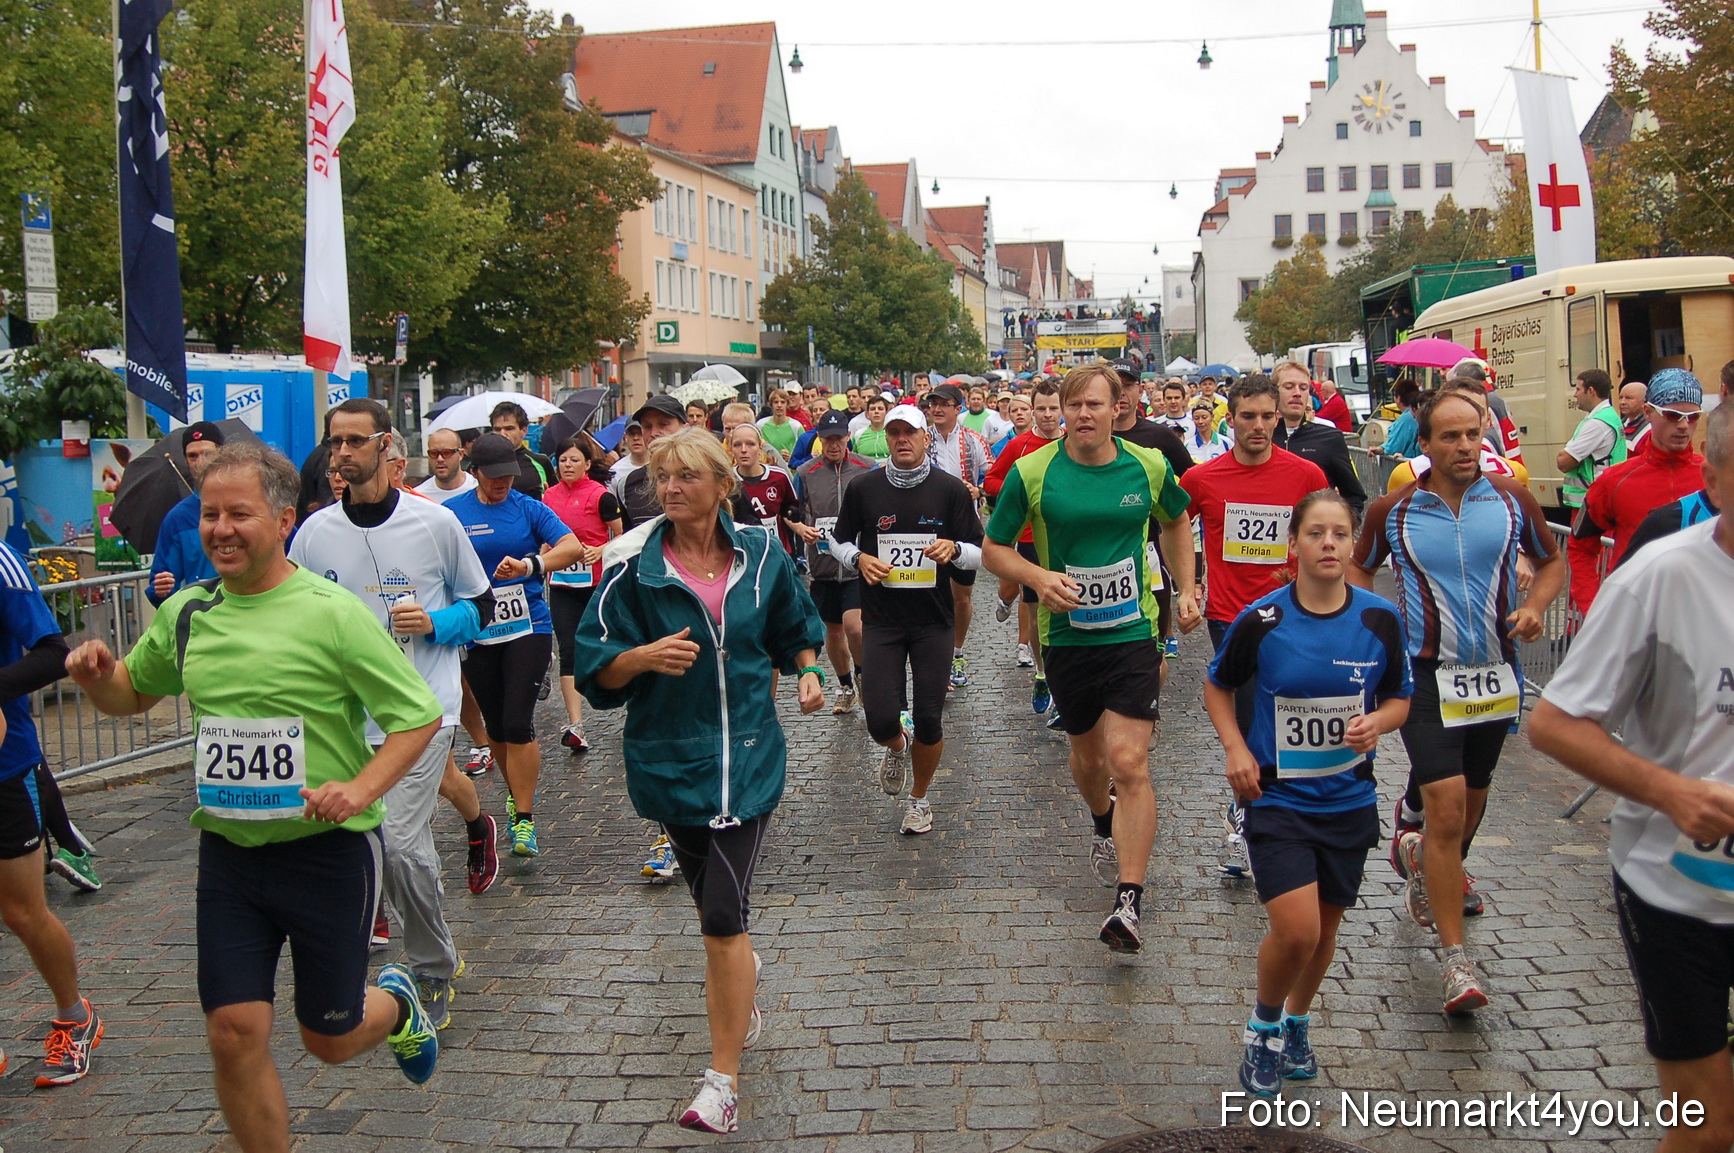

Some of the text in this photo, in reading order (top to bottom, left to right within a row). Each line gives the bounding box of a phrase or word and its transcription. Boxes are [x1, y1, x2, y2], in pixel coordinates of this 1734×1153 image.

[660, 324, 676, 340] D
[1492, 317, 1542, 345] Bayerisches
[1065, 338, 1096, 346] START
[1491, 348, 1515, 366] Rotes
[1120, 493, 1143, 505] AOK
[1249, 510, 1281, 518] Neumarkt
[1237, 518, 1279, 541] 324
[889, 547, 925, 568] 237
[1241, 546, 1271, 556] Florian
[899, 572, 916, 581] Ralf
[1067, 568, 1125, 581] PARTL Neumarkt
[1074, 575, 1133, 606] 2948
[491, 598, 524, 623] 30
[1085, 608, 1124, 621] Gerhard
[488, 625, 514, 637] Gisela
[1453, 670, 1502, 698] 516
[1277, 704, 1357, 714] PARTL Neumarkt
[1465, 703, 1495, 715] Oliver
[201, 727, 283, 739] PARTL Neumarkt
[1286, 713, 1361, 747] 309
[206, 742, 295, 781] 2548
[218, 789, 281, 806] Christian
